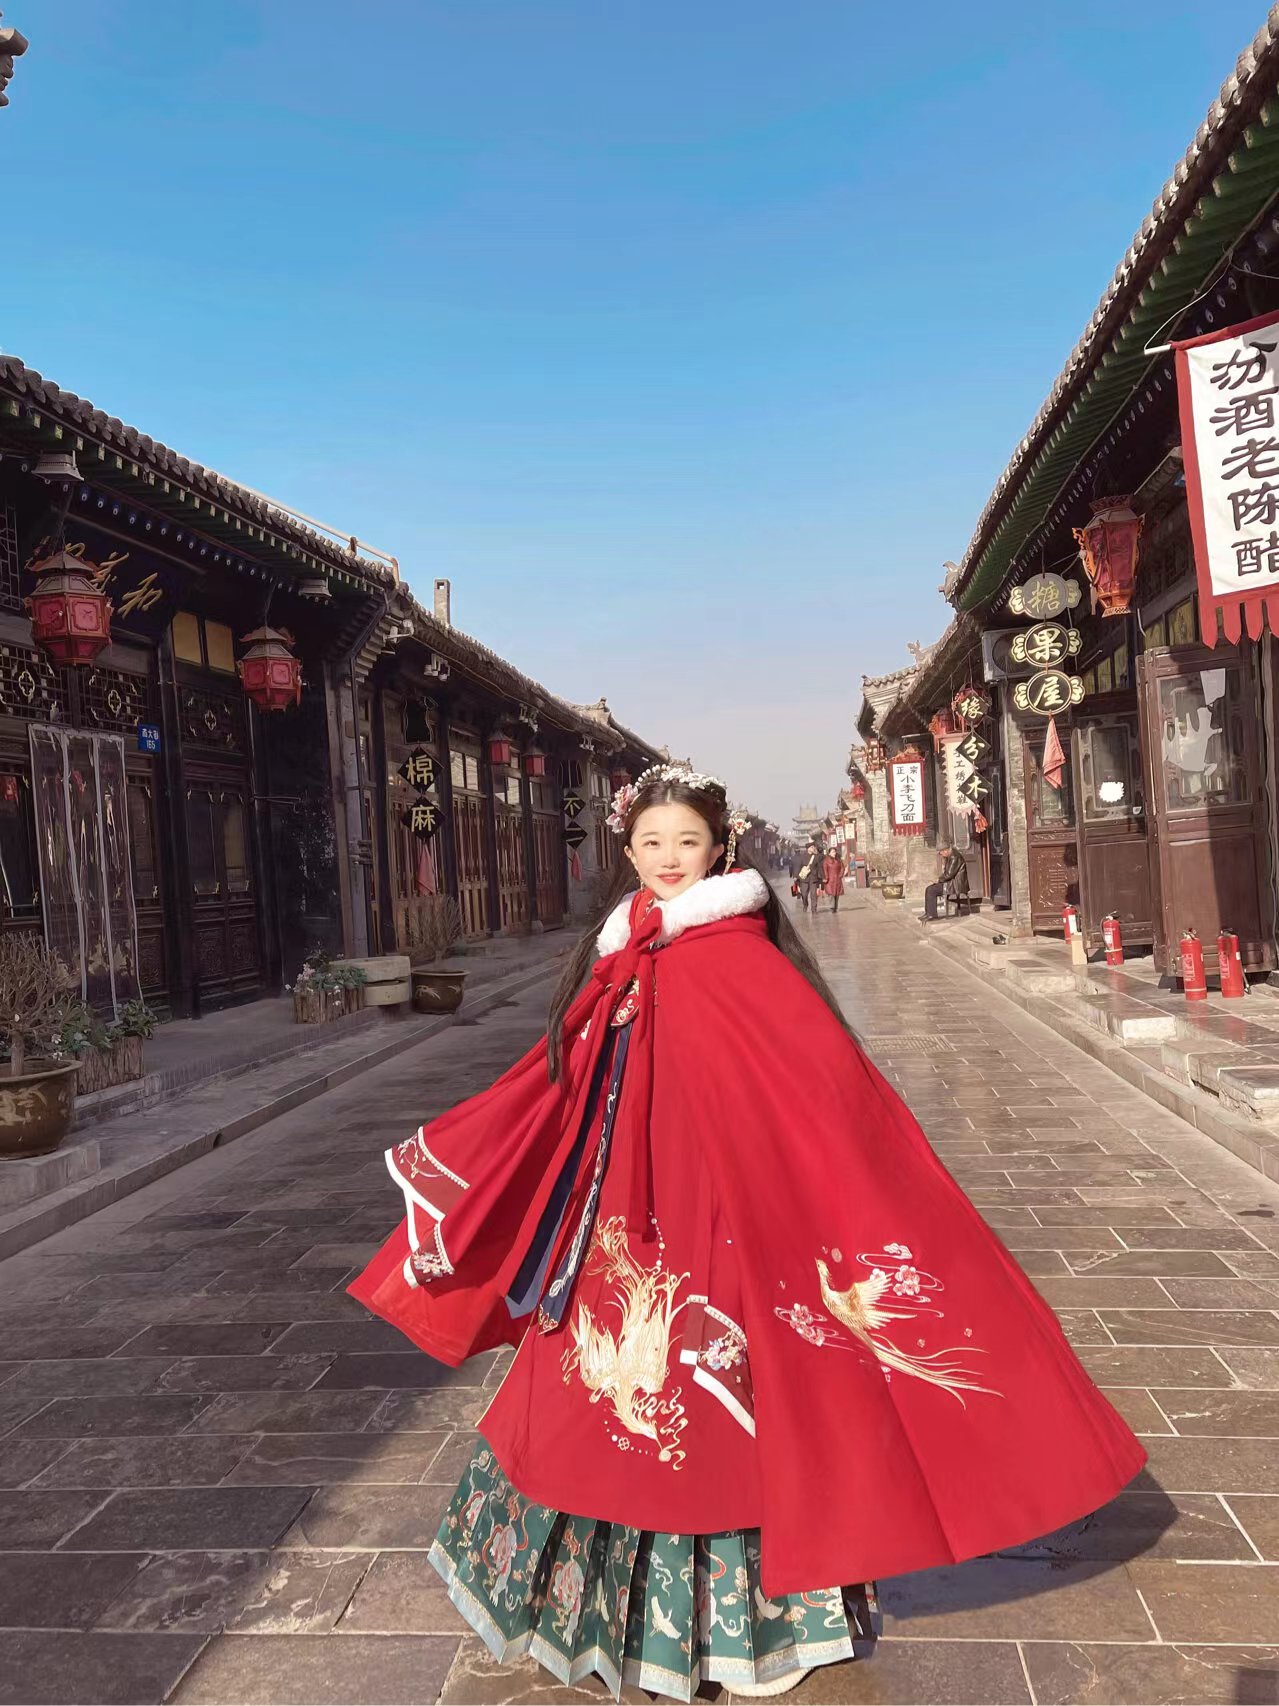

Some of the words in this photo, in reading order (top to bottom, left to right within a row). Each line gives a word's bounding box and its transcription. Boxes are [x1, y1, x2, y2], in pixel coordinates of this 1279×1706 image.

[1027, 580, 1064, 707] 糖果屋
[896, 765, 918, 775] 正宗
[960, 696, 989, 800] 缘分木
[405, 754, 436, 832] 棉麻
[563, 797, 584, 841] 不二
[899, 774, 916, 822] 小李飞刀面
